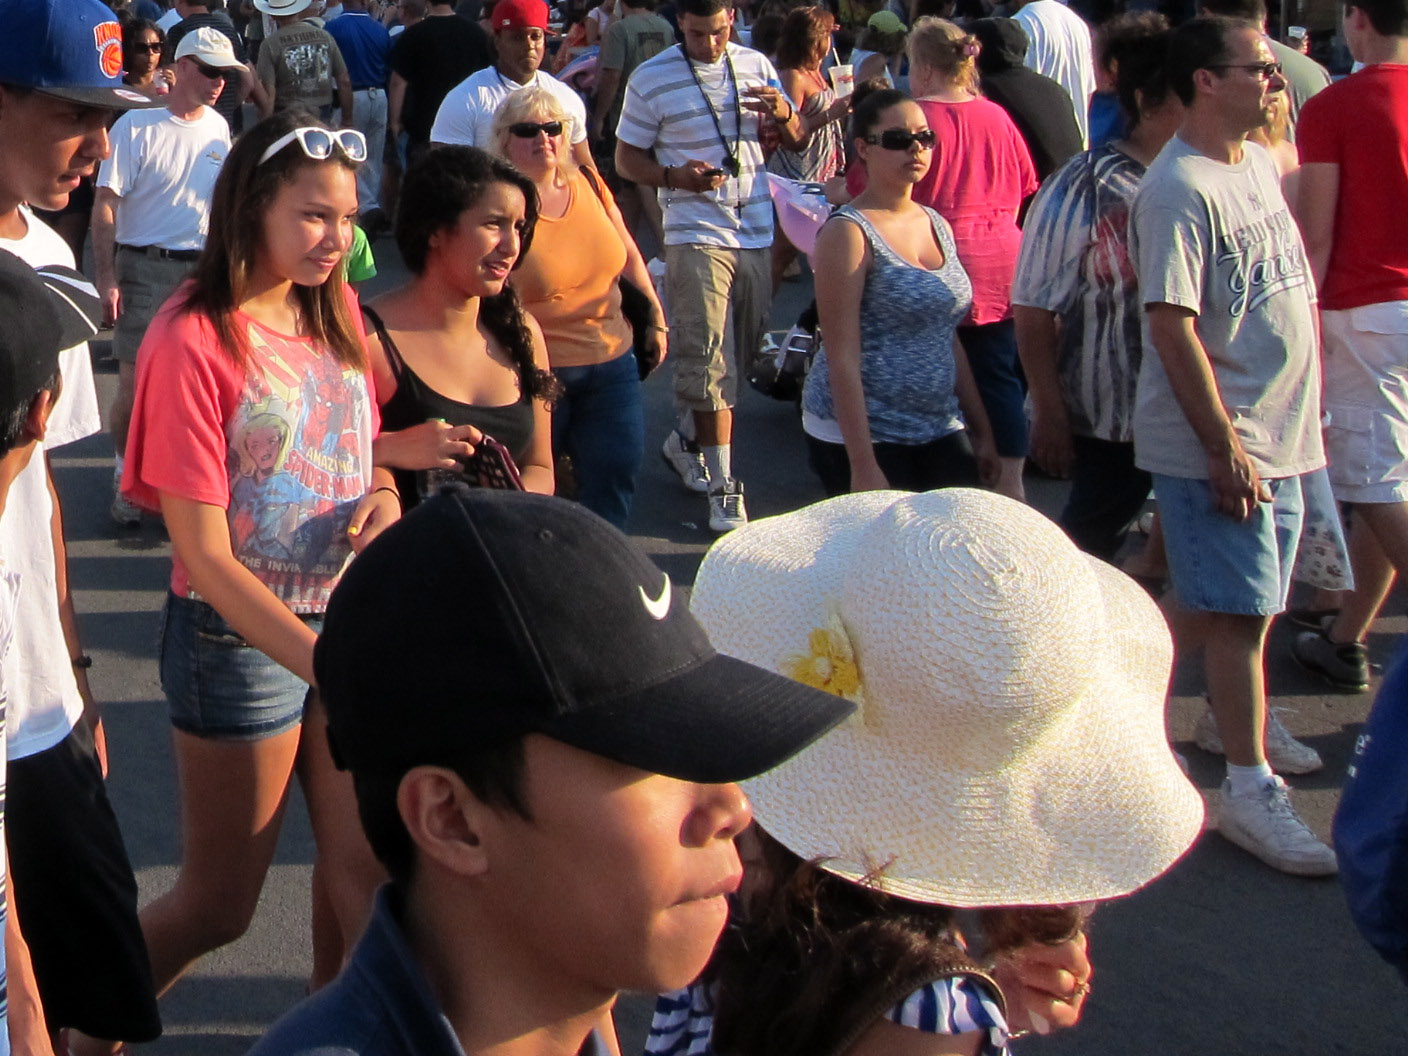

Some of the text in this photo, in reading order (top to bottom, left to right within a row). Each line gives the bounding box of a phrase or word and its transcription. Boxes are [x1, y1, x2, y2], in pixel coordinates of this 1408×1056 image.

[306, 446, 354, 474] AMAZING
[283, 448, 364, 501] SPIDER-MAN
[238, 555, 262, 569] THE
